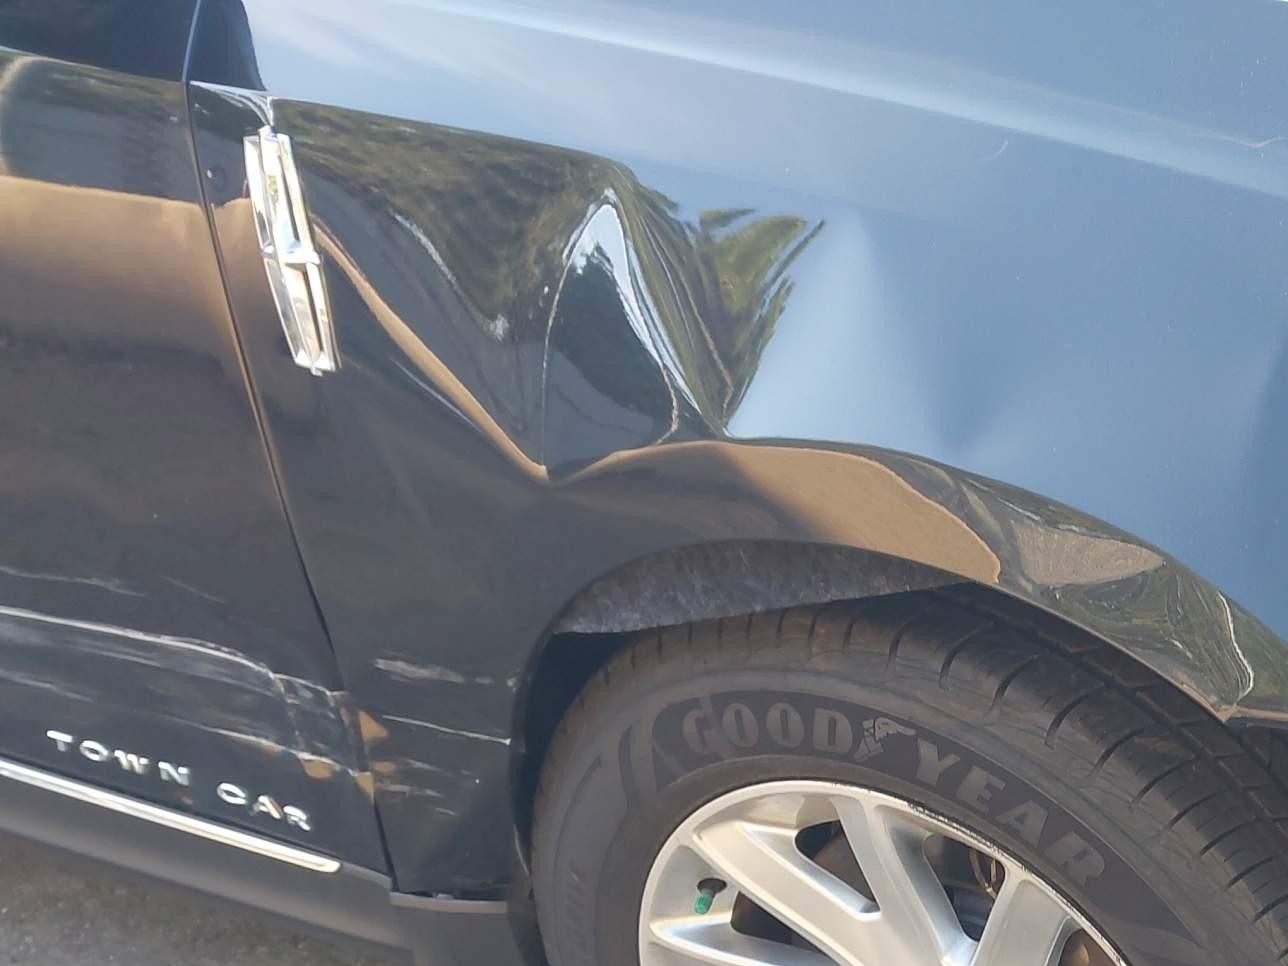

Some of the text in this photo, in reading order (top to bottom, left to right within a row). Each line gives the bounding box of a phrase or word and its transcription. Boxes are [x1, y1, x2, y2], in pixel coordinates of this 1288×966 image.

[46, 729, 312, 832] TOWN CAR
[681, 701, 1106, 886] GOOD YEAR
